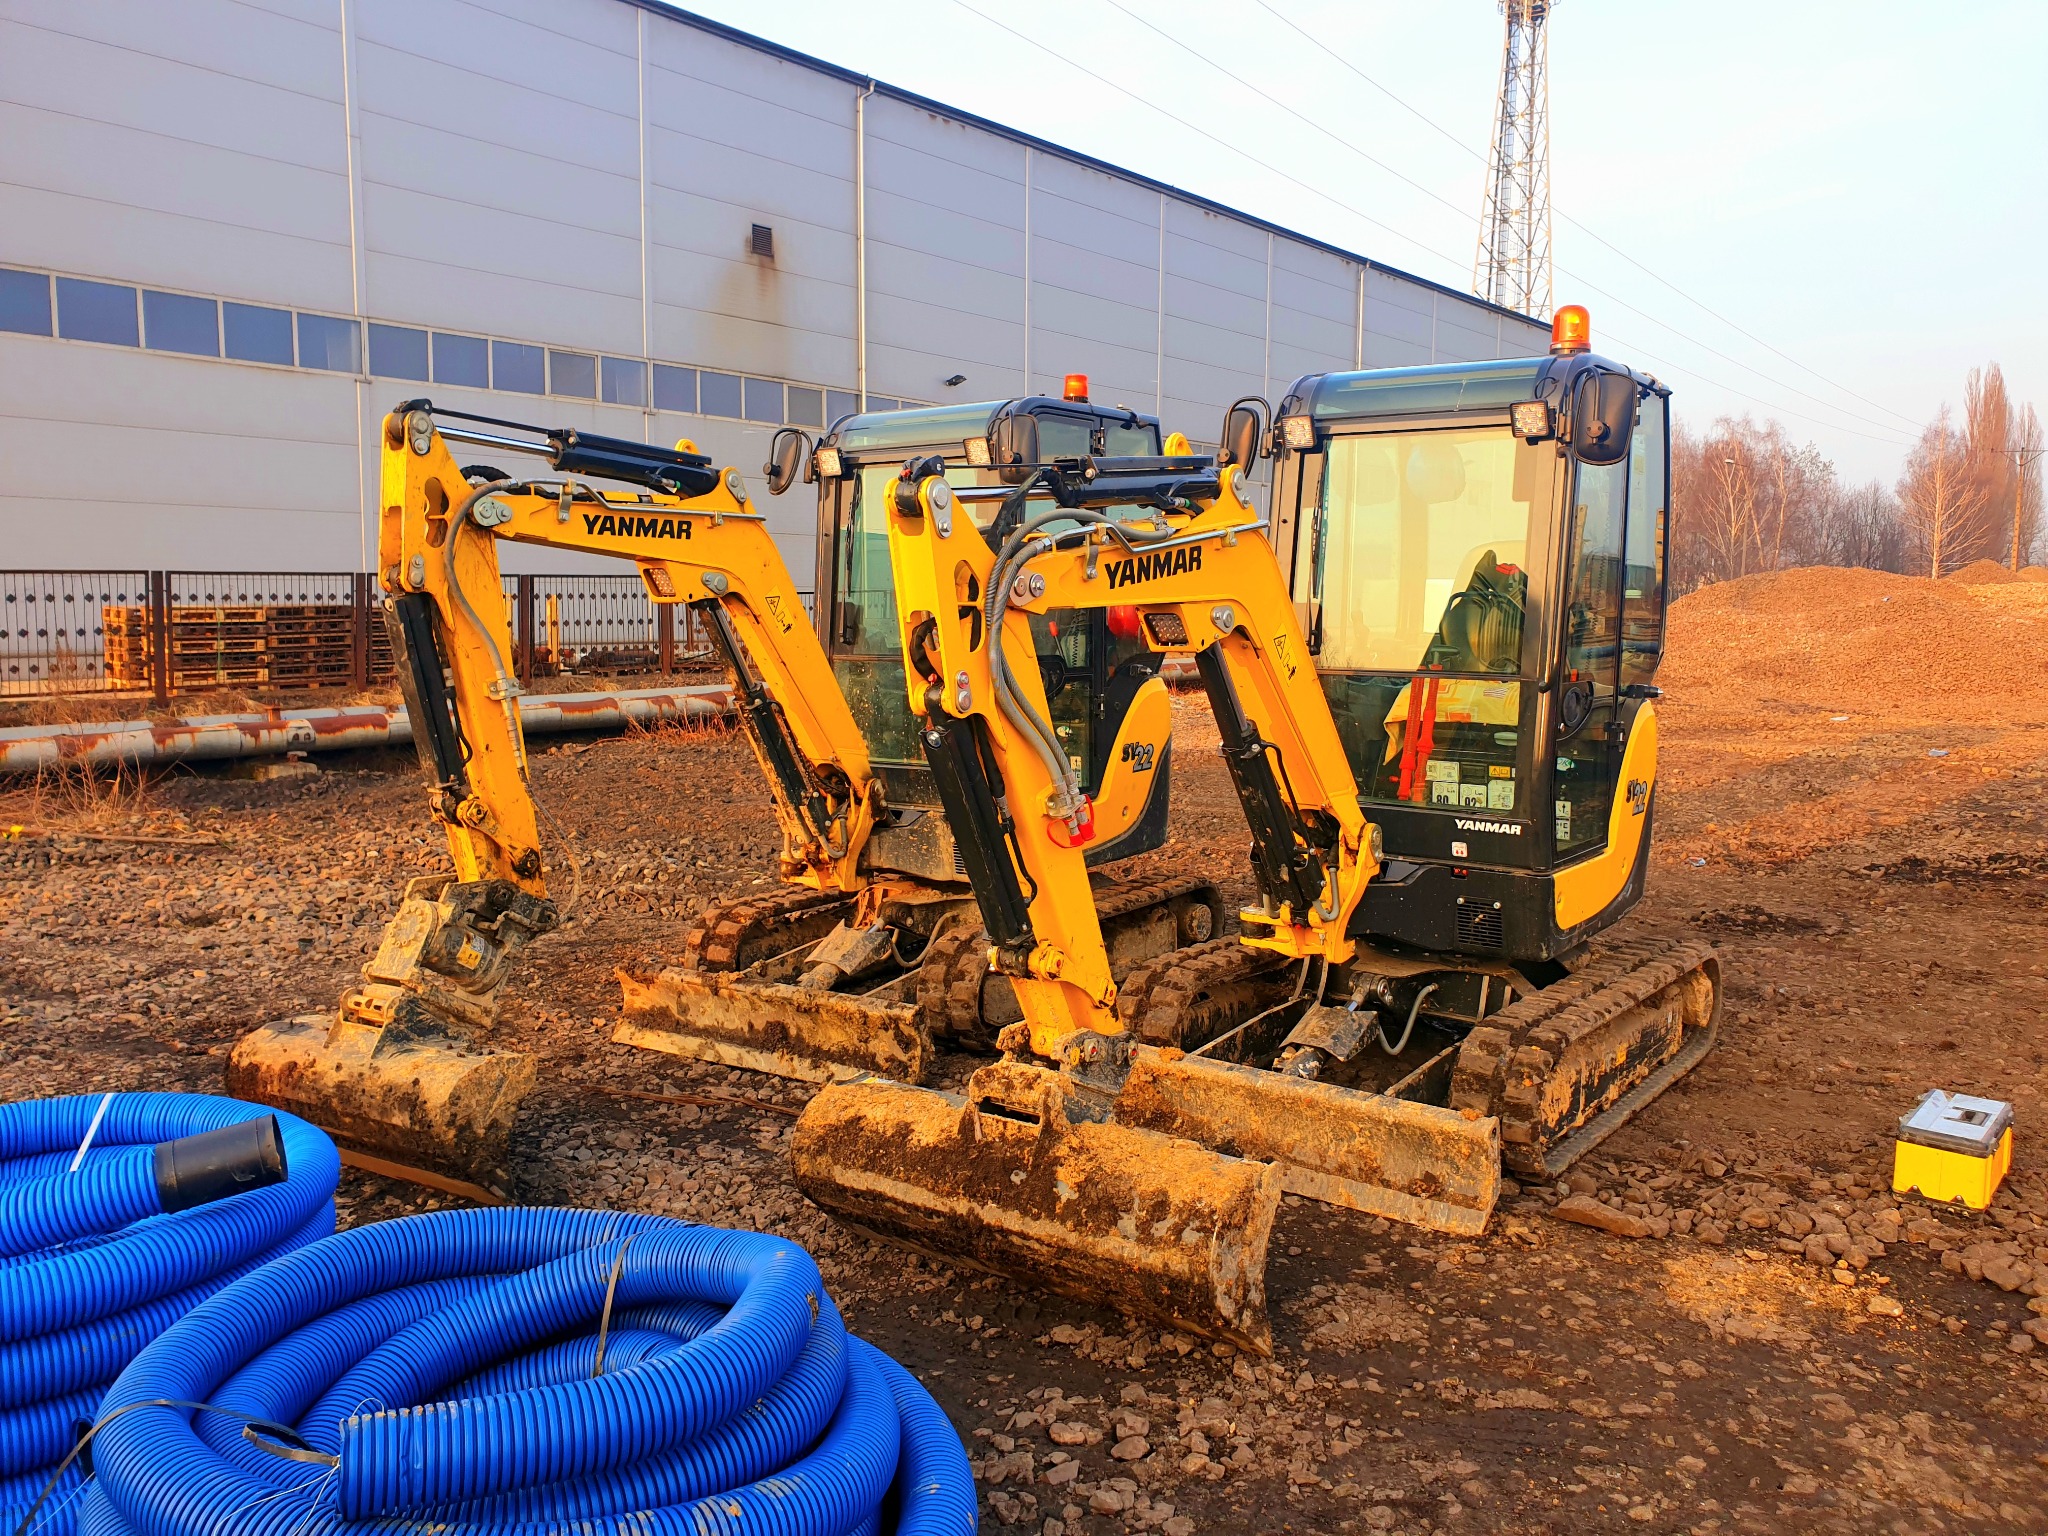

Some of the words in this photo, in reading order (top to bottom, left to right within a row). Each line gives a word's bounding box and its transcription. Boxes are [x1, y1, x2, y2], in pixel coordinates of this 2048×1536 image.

[583, 514, 692, 540] YANMAR
[1104, 545, 1202, 589] YANMAR
[1454, 819, 1522, 836] YANMAR
